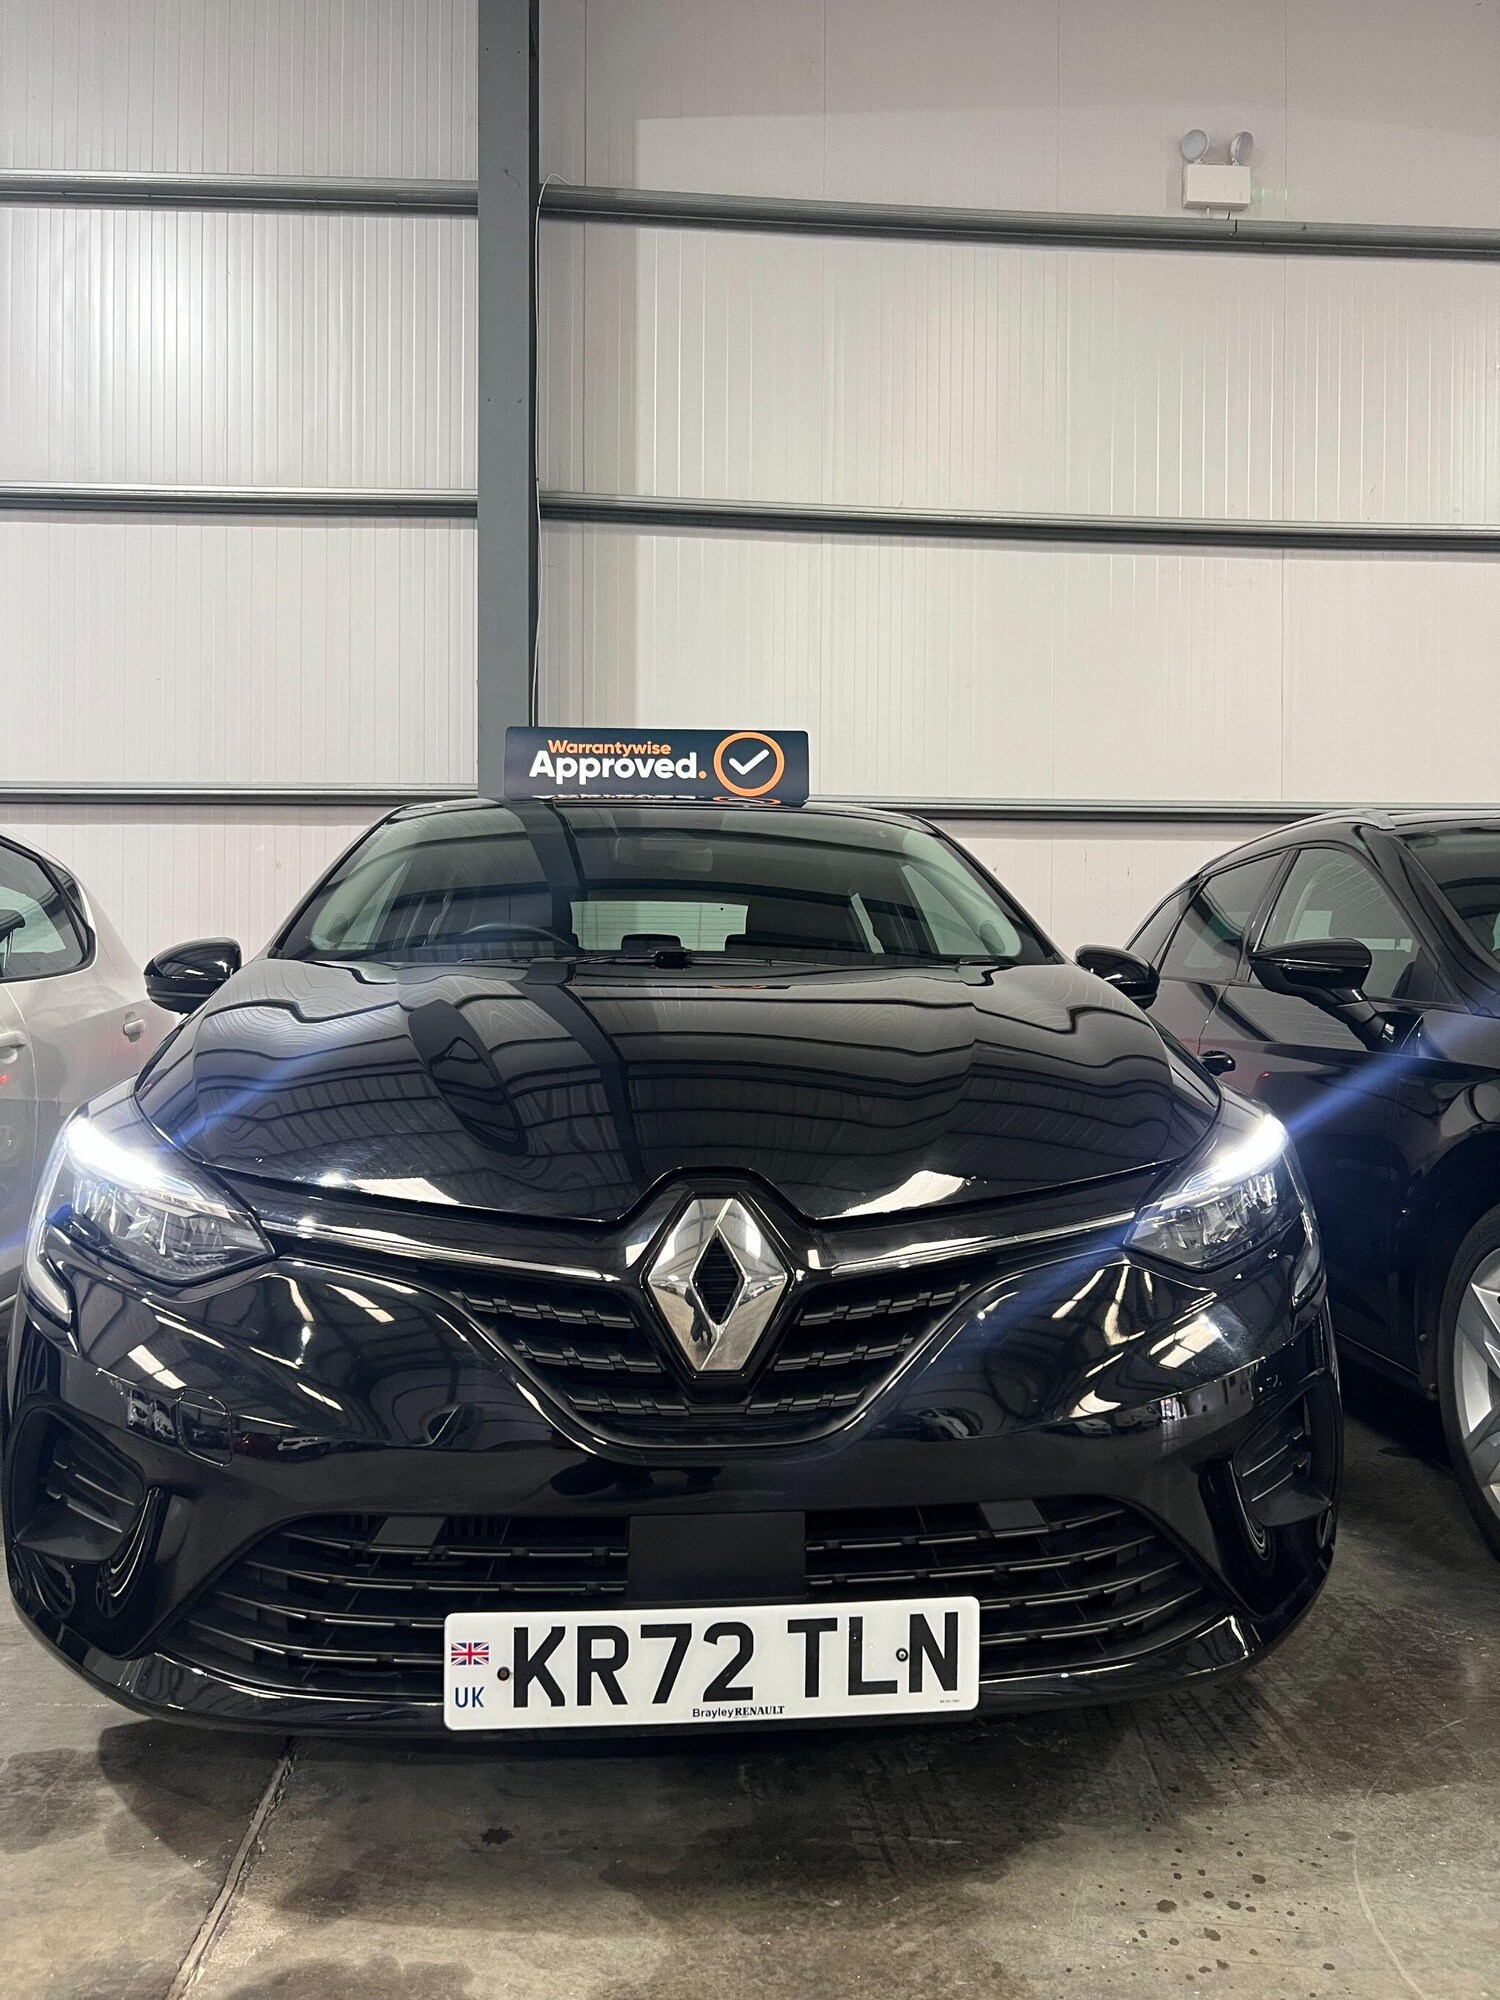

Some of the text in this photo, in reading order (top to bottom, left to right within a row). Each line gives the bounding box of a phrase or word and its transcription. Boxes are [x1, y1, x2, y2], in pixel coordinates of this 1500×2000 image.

[548, 740, 671, 758] Warrantywise
[529, 750, 707, 785] Approved.
[512, 1611, 960, 1709] KR72 TLN
[455, 1686, 485, 1708] UK
